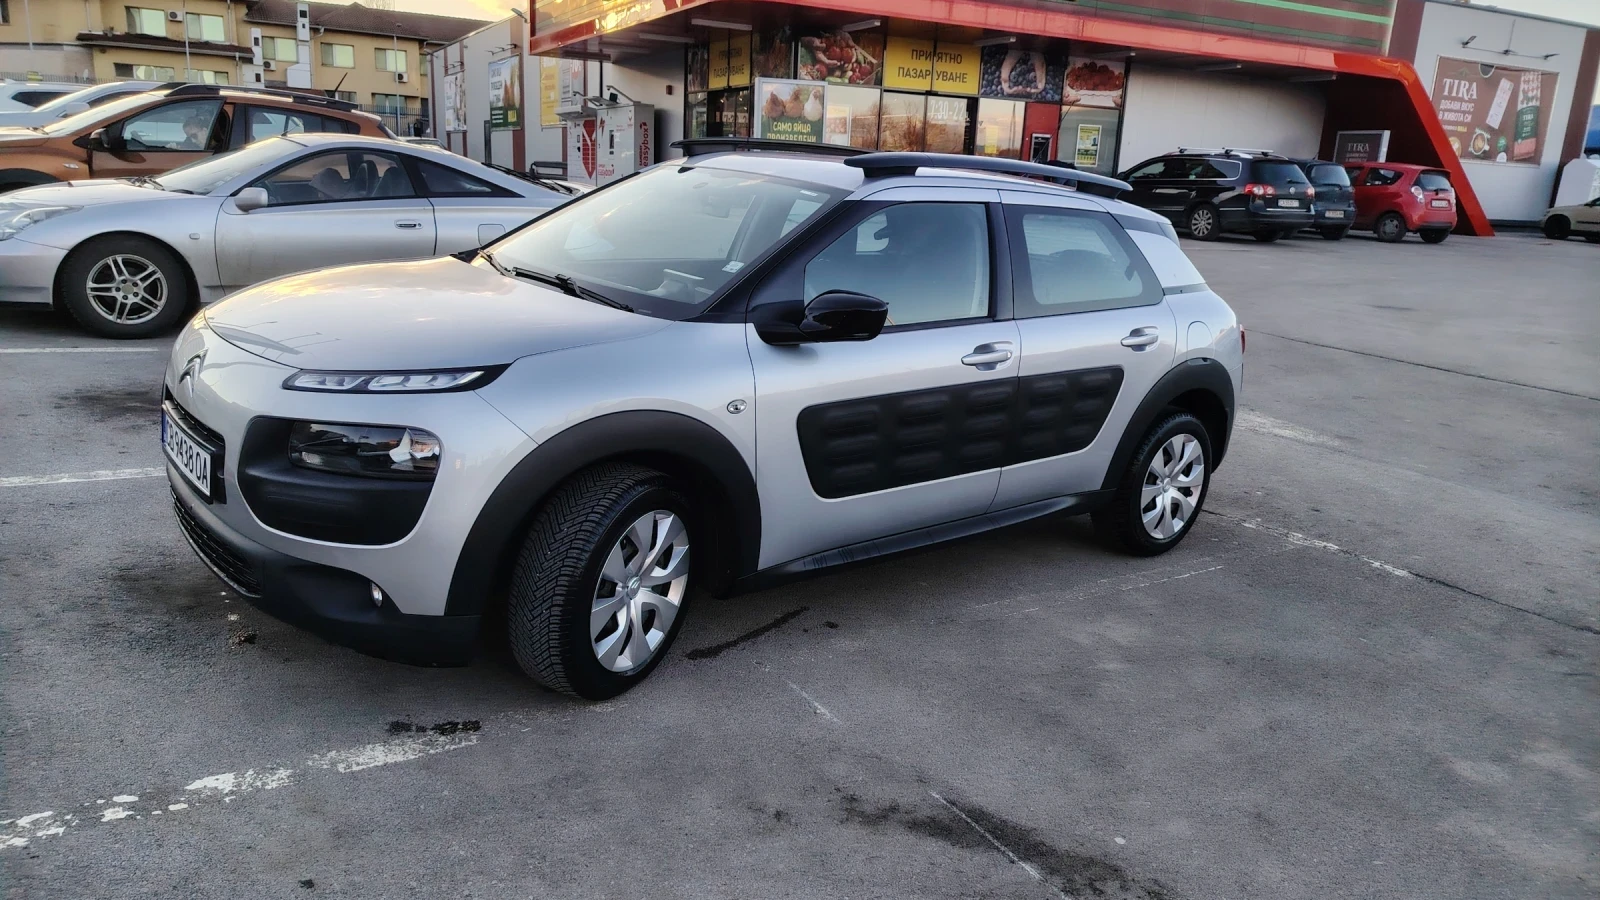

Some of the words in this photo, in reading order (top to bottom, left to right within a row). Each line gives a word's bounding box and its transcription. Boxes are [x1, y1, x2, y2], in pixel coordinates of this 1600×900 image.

[911, 49, 963, 64] ПРИЯТНО
[897, 66, 968, 83] ПАЗАРУВАНЕ
[1443, 78, 1477, 101] TIRA
[1460, 102, 1475, 112] ВКУС
[1438, 110, 1443, 120] В
[1443, 111, 1464, 122] ЖИВОТА
[1464, 113, 1473, 122] СИ
[773, 121, 792, 132] САМО
[793, 120, 811, 133] ЯЙЦА
[642, 127, 650, 167] easybox
[1347, 143, 1370, 152] TIRA
[174, 430, 194, 474] 9438
[195, 451, 208, 489] OA
